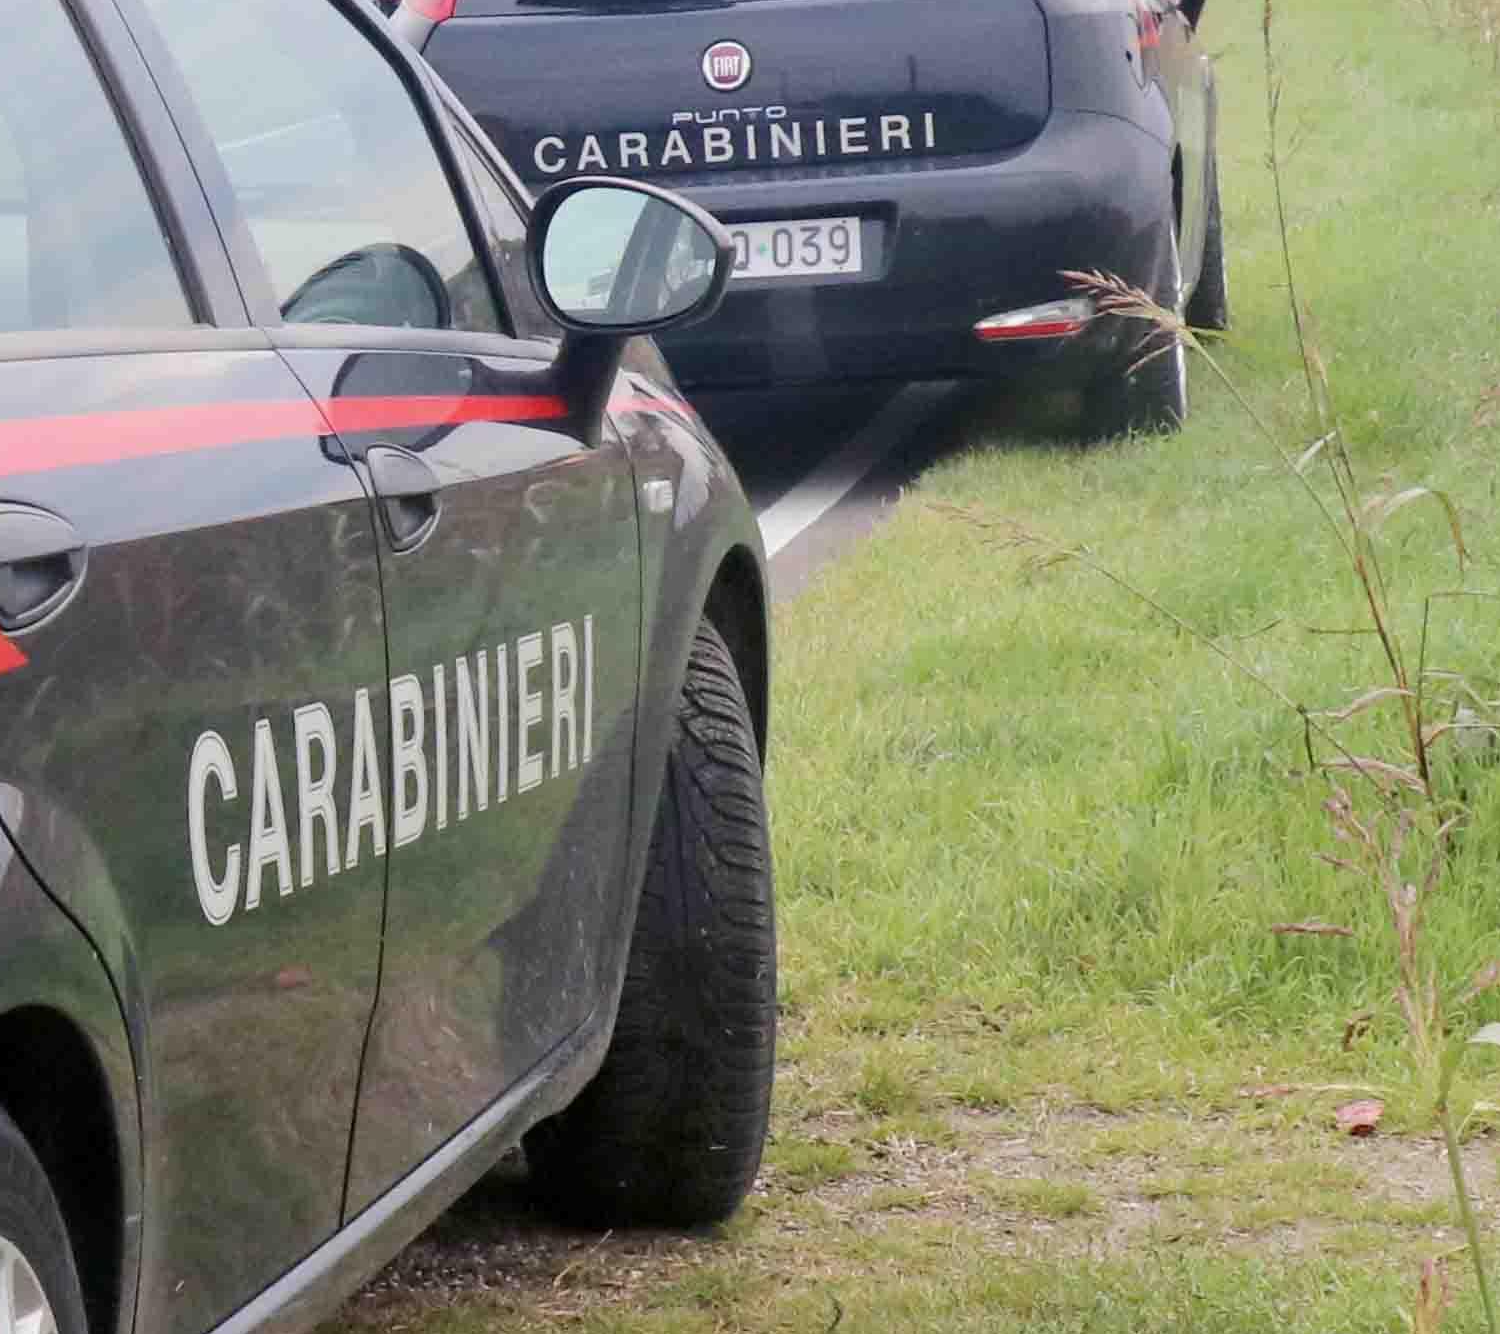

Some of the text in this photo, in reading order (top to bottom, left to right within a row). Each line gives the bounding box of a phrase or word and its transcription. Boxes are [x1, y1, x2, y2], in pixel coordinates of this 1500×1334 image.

[713, 56, 740, 77] FIAT
[672, 105, 788, 126] PUNTO
[534, 112, 936, 173] CARABINIERI
[772, 224, 851, 268] 039
[188, 614, 593, 926] CARABINIERI
